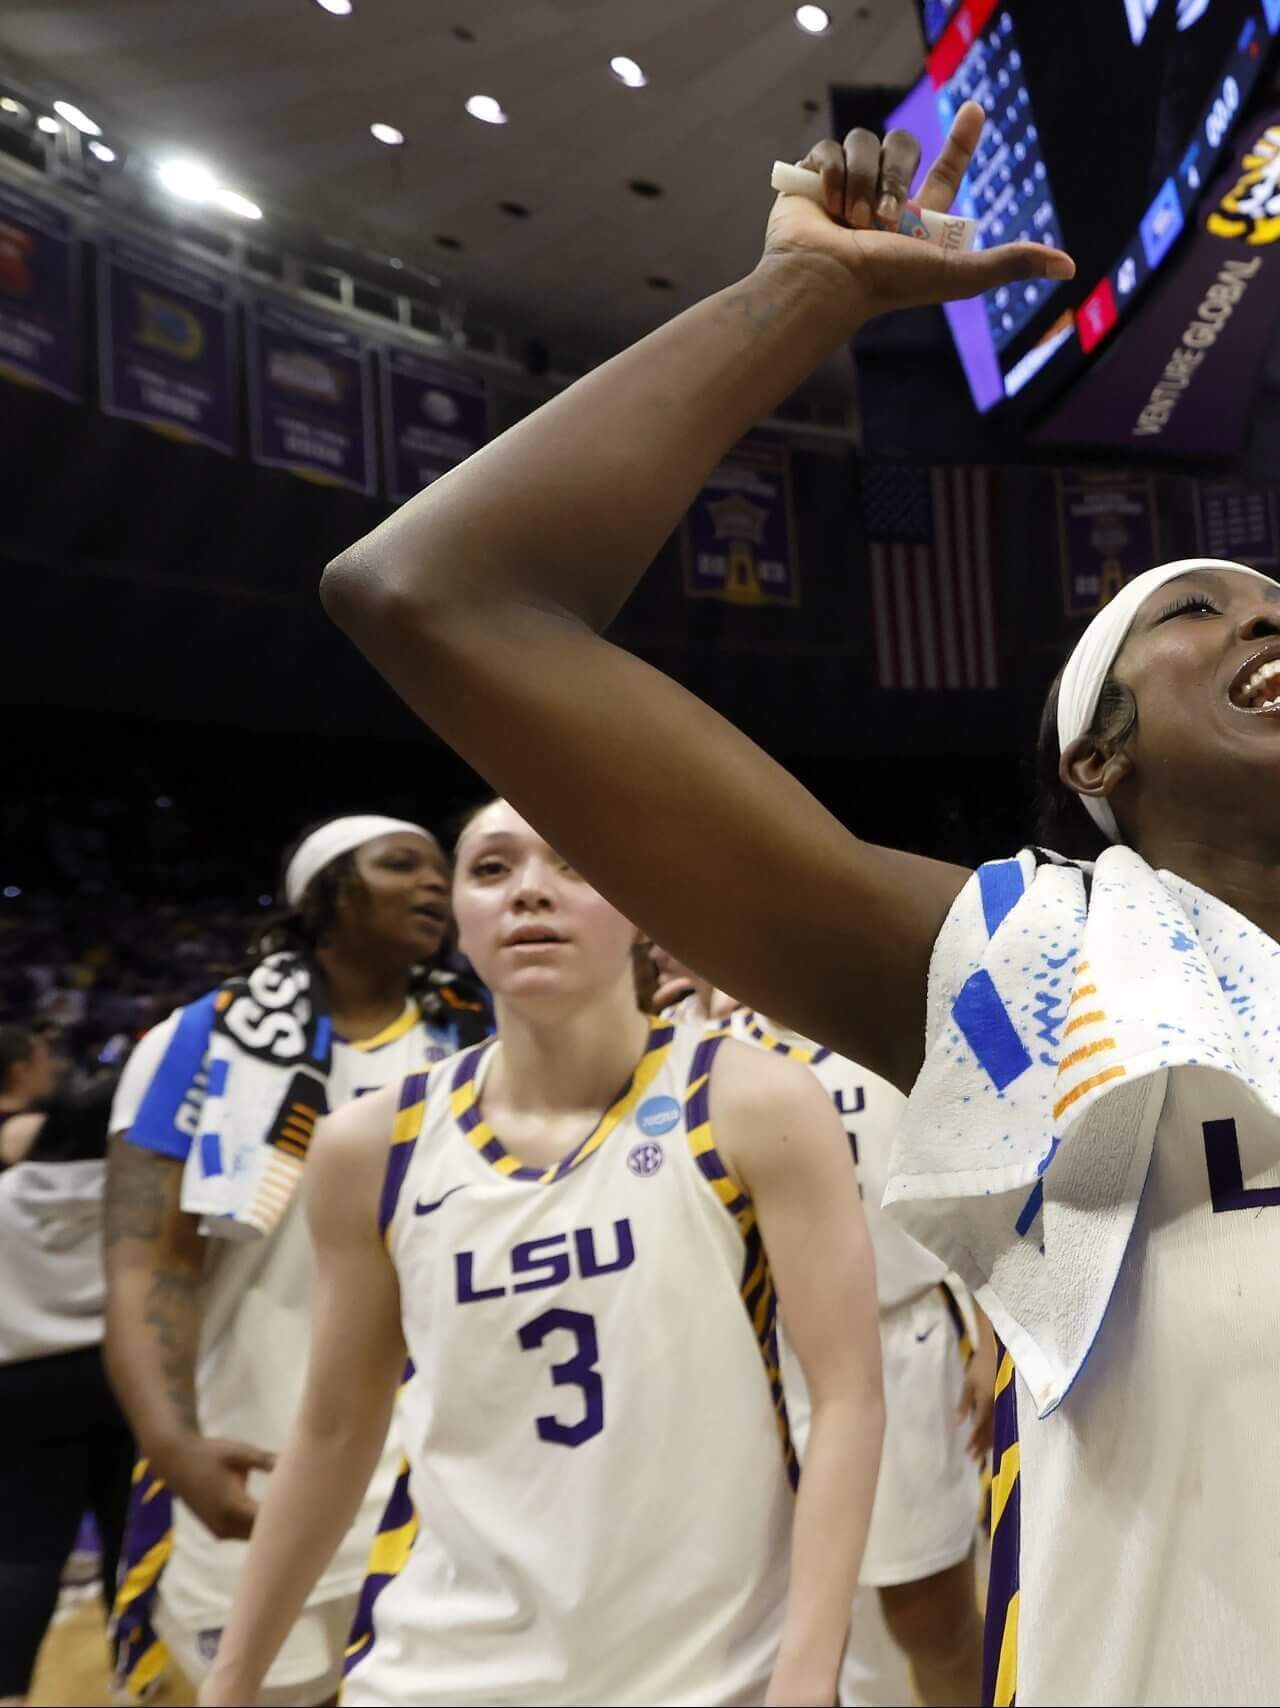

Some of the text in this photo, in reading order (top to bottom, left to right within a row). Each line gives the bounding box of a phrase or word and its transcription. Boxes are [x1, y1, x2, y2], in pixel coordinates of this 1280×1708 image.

[1132, 255, 1263, 436] VENTURE GLOBAL
[454, 1218, 635, 1304] LSU
[516, 1308, 604, 1448] 3
